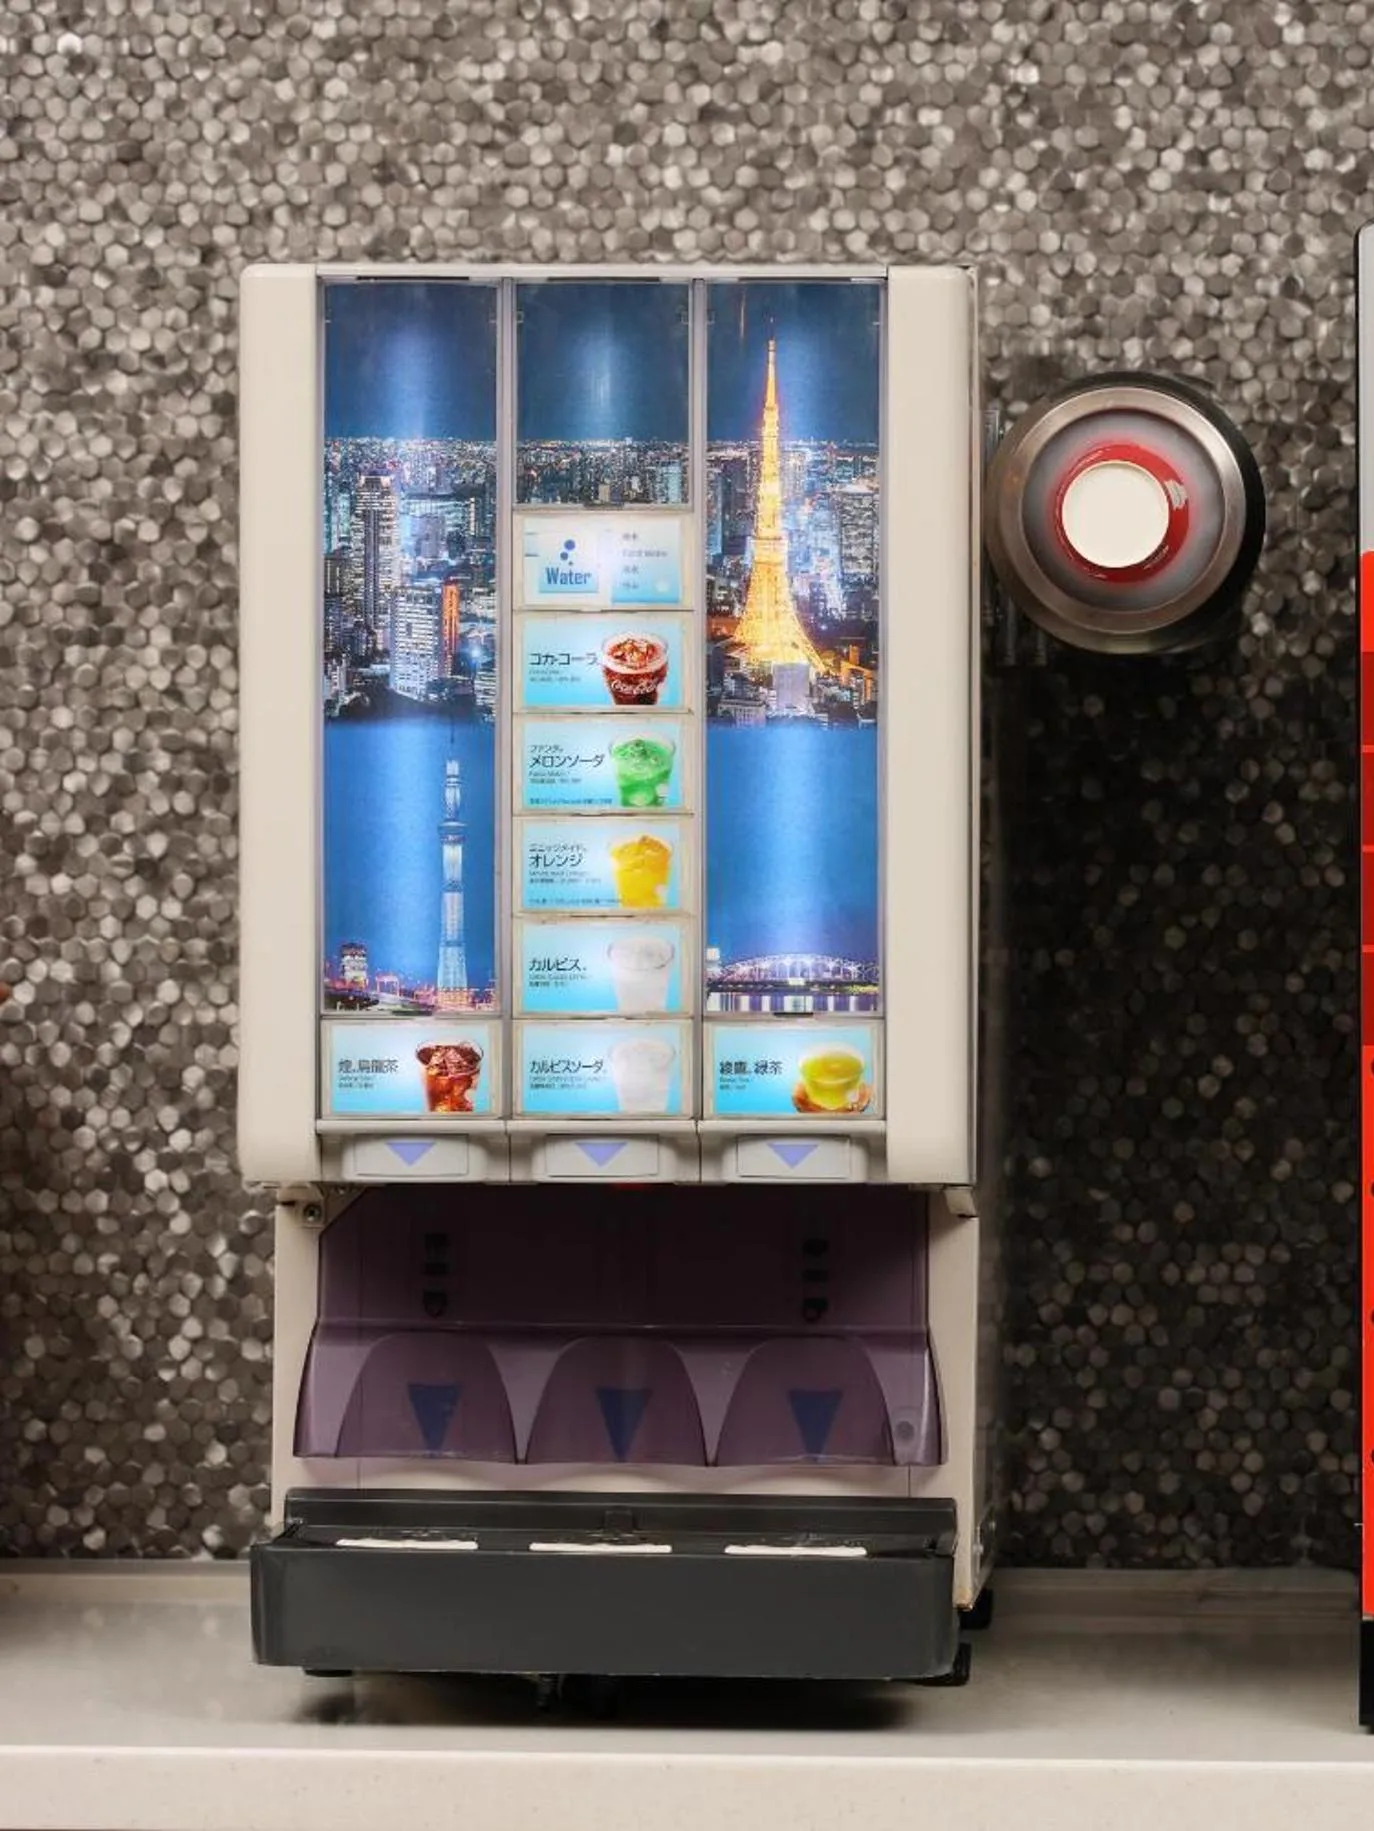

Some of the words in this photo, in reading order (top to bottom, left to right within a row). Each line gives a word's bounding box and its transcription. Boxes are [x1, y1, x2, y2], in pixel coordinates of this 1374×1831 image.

[545, 567, 592, 585] Water
[529, 753, 606, 768] メロンソーダ
[529, 852, 583, 868] オレンジ
